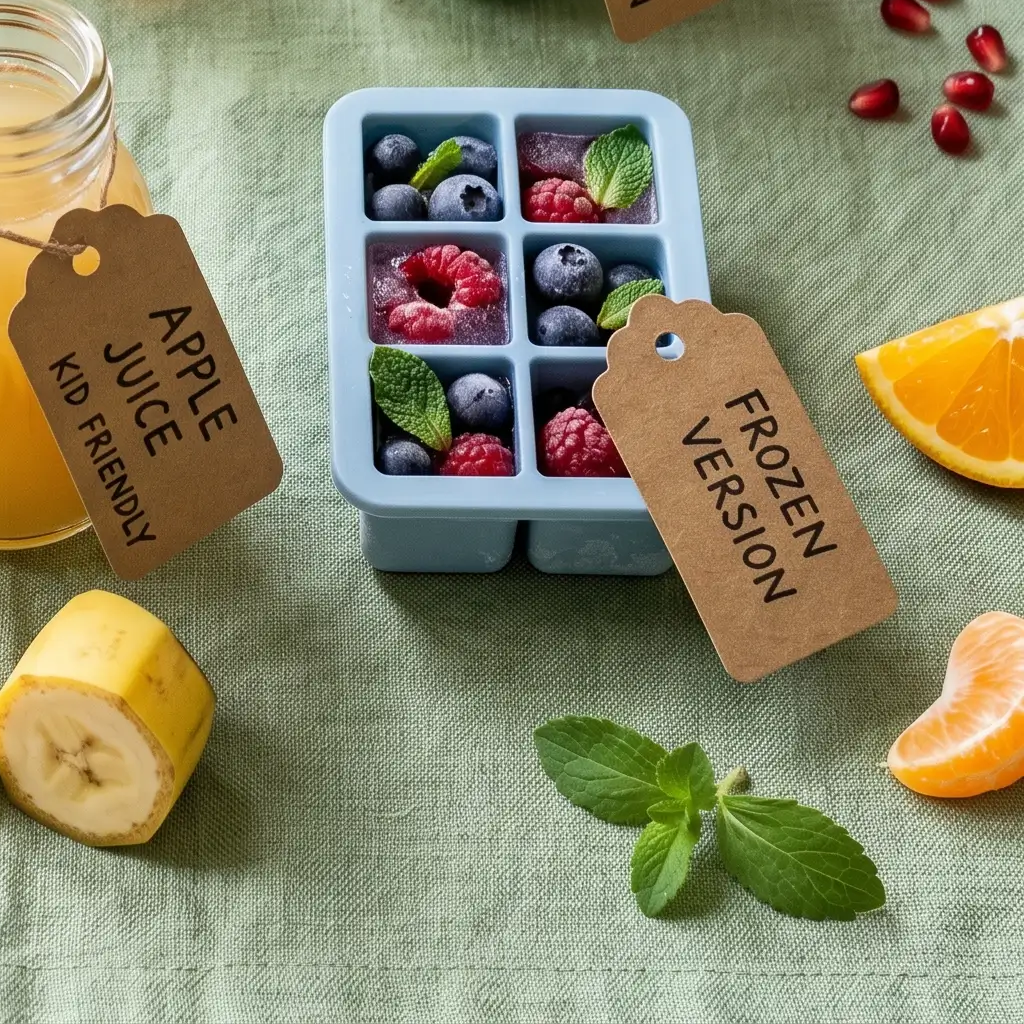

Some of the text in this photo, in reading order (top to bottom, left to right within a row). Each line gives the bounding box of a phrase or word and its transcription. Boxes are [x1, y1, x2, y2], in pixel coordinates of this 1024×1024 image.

[49, 351, 156, 547] KID FRIENDLY
[104, 341, 182, 457] JUICE
[148, 305, 238, 442] APPLE
[682, 415, 797, 604] VERSION
[725, 388, 838, 558] FROZEN
